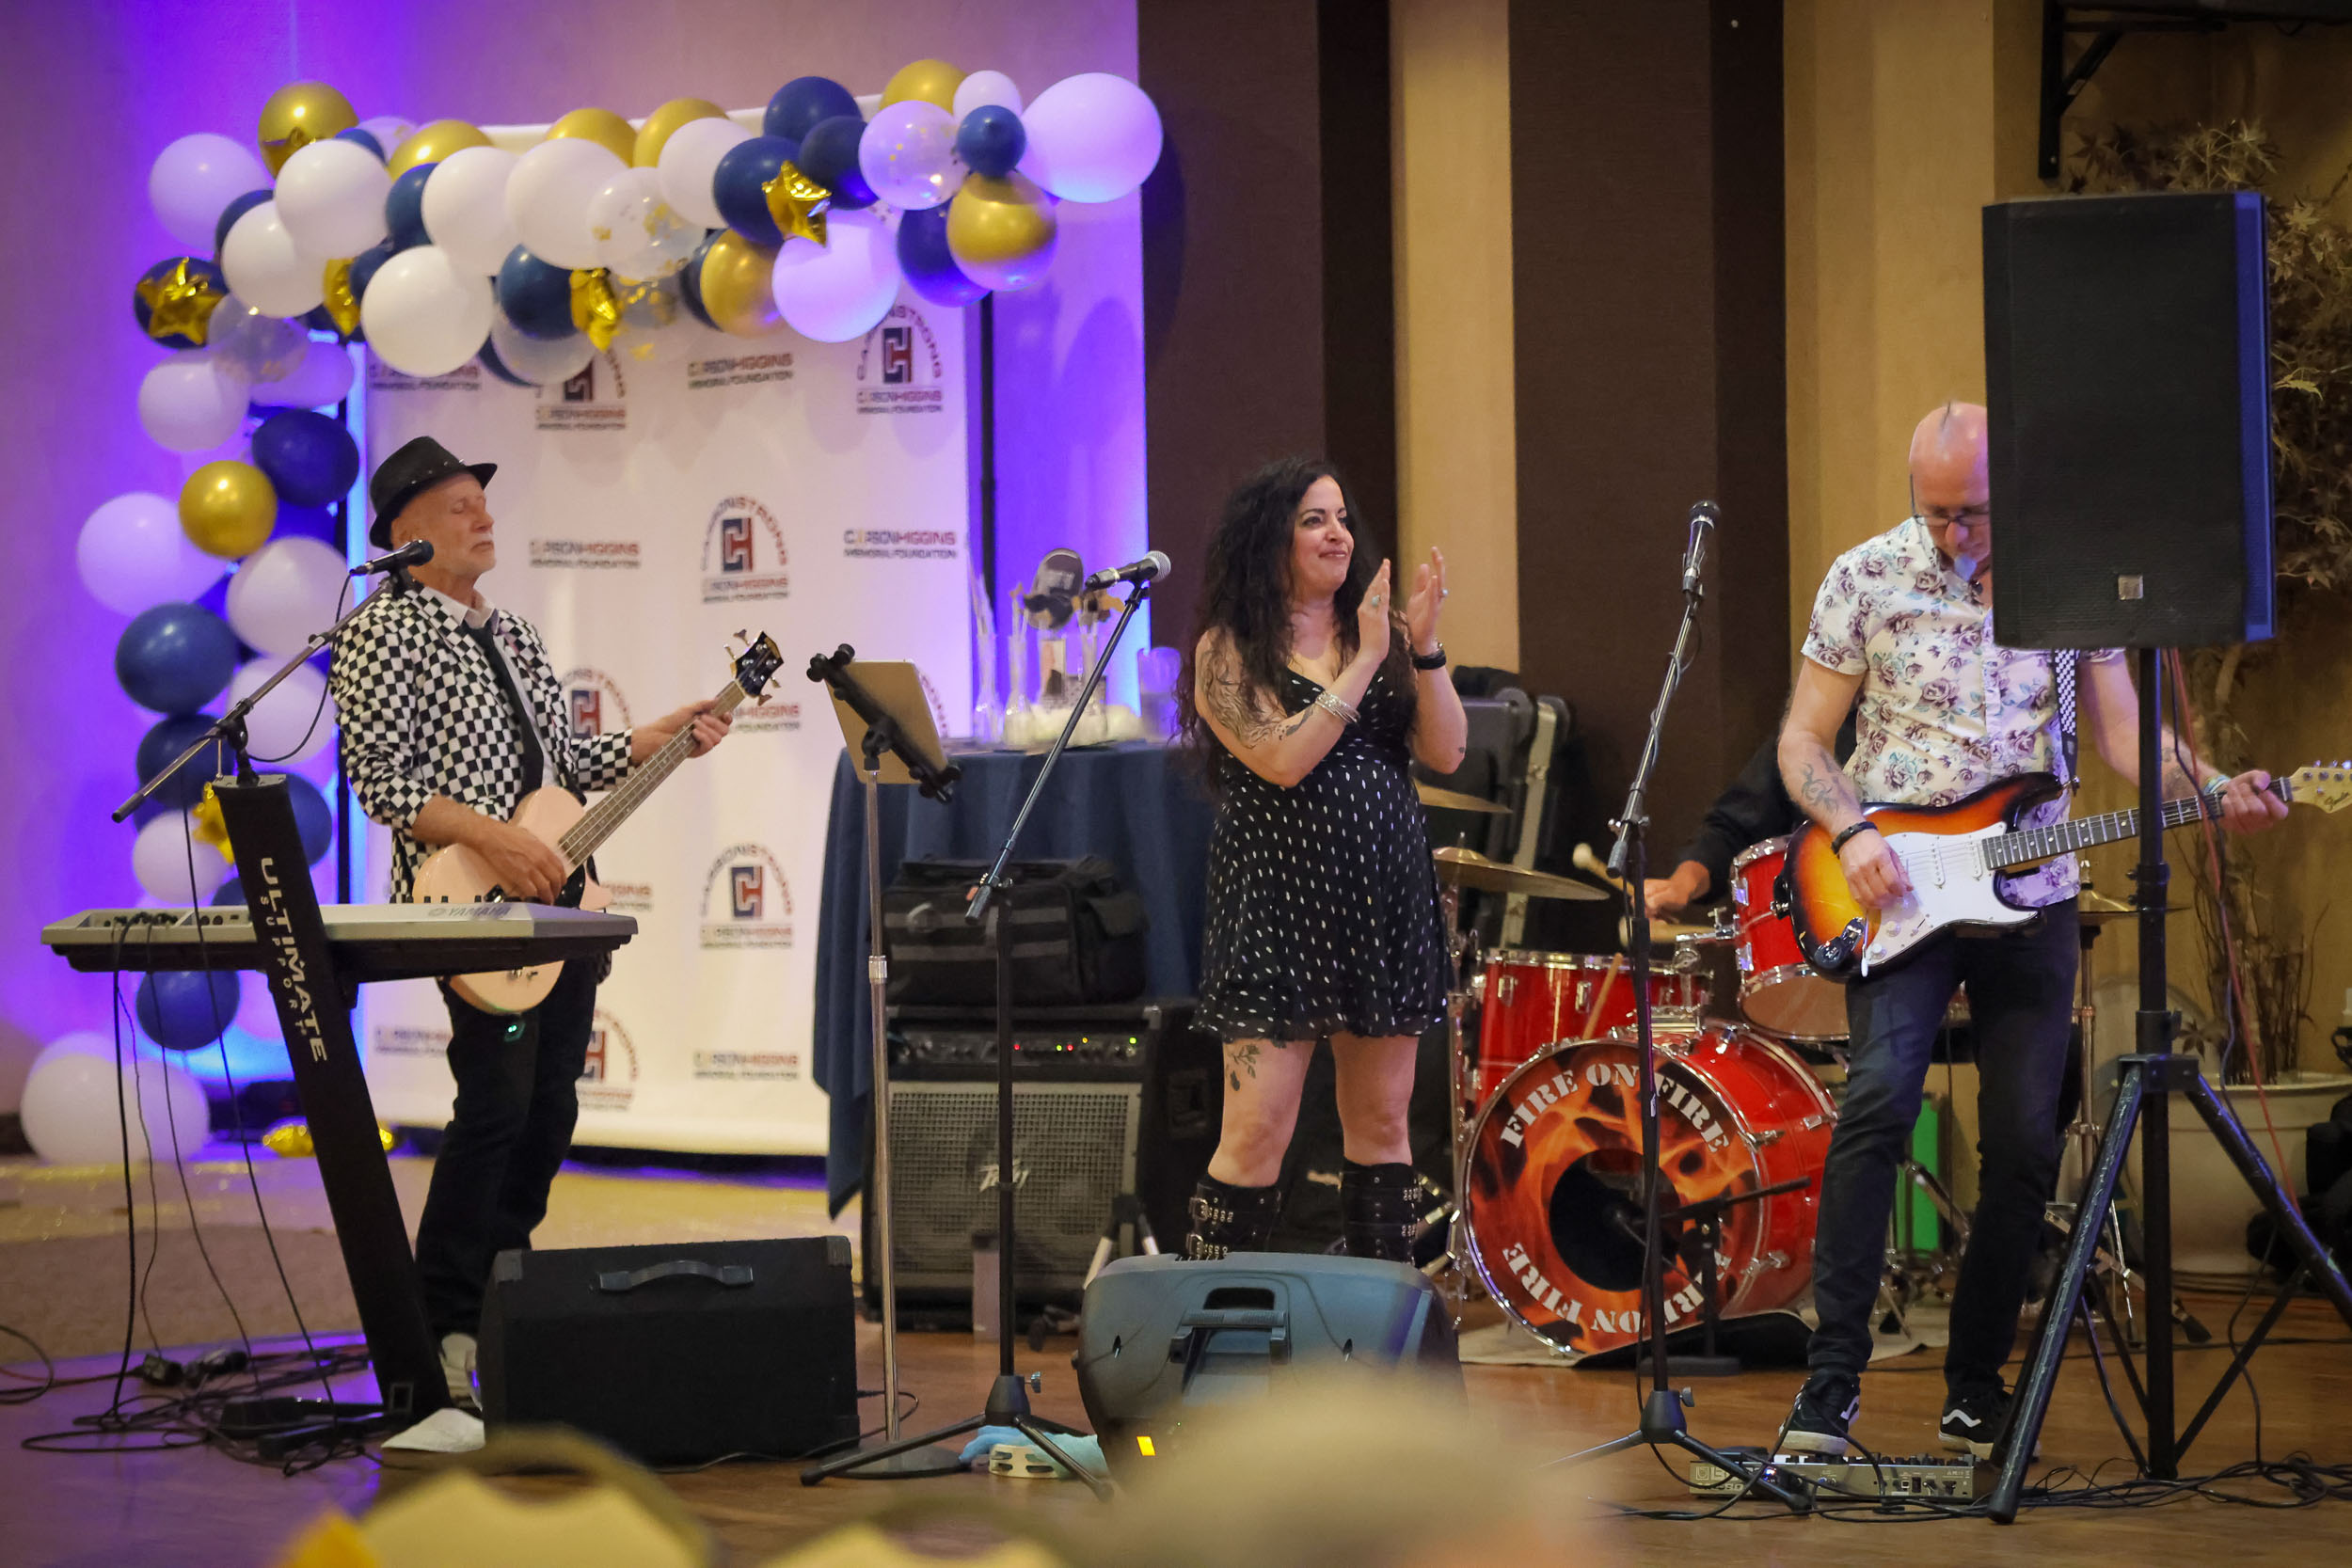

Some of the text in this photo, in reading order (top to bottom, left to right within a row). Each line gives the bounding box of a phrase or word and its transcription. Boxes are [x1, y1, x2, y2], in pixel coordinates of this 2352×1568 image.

[260, 895, 307, 1035] SUPPORT
[261, 857, 327, 1062] ULTIMATE
[1501, 1063, 1730, 1152] FIRE ON FIRE
[1502, 1242, 1732, 1333] FRE ON FIRE
